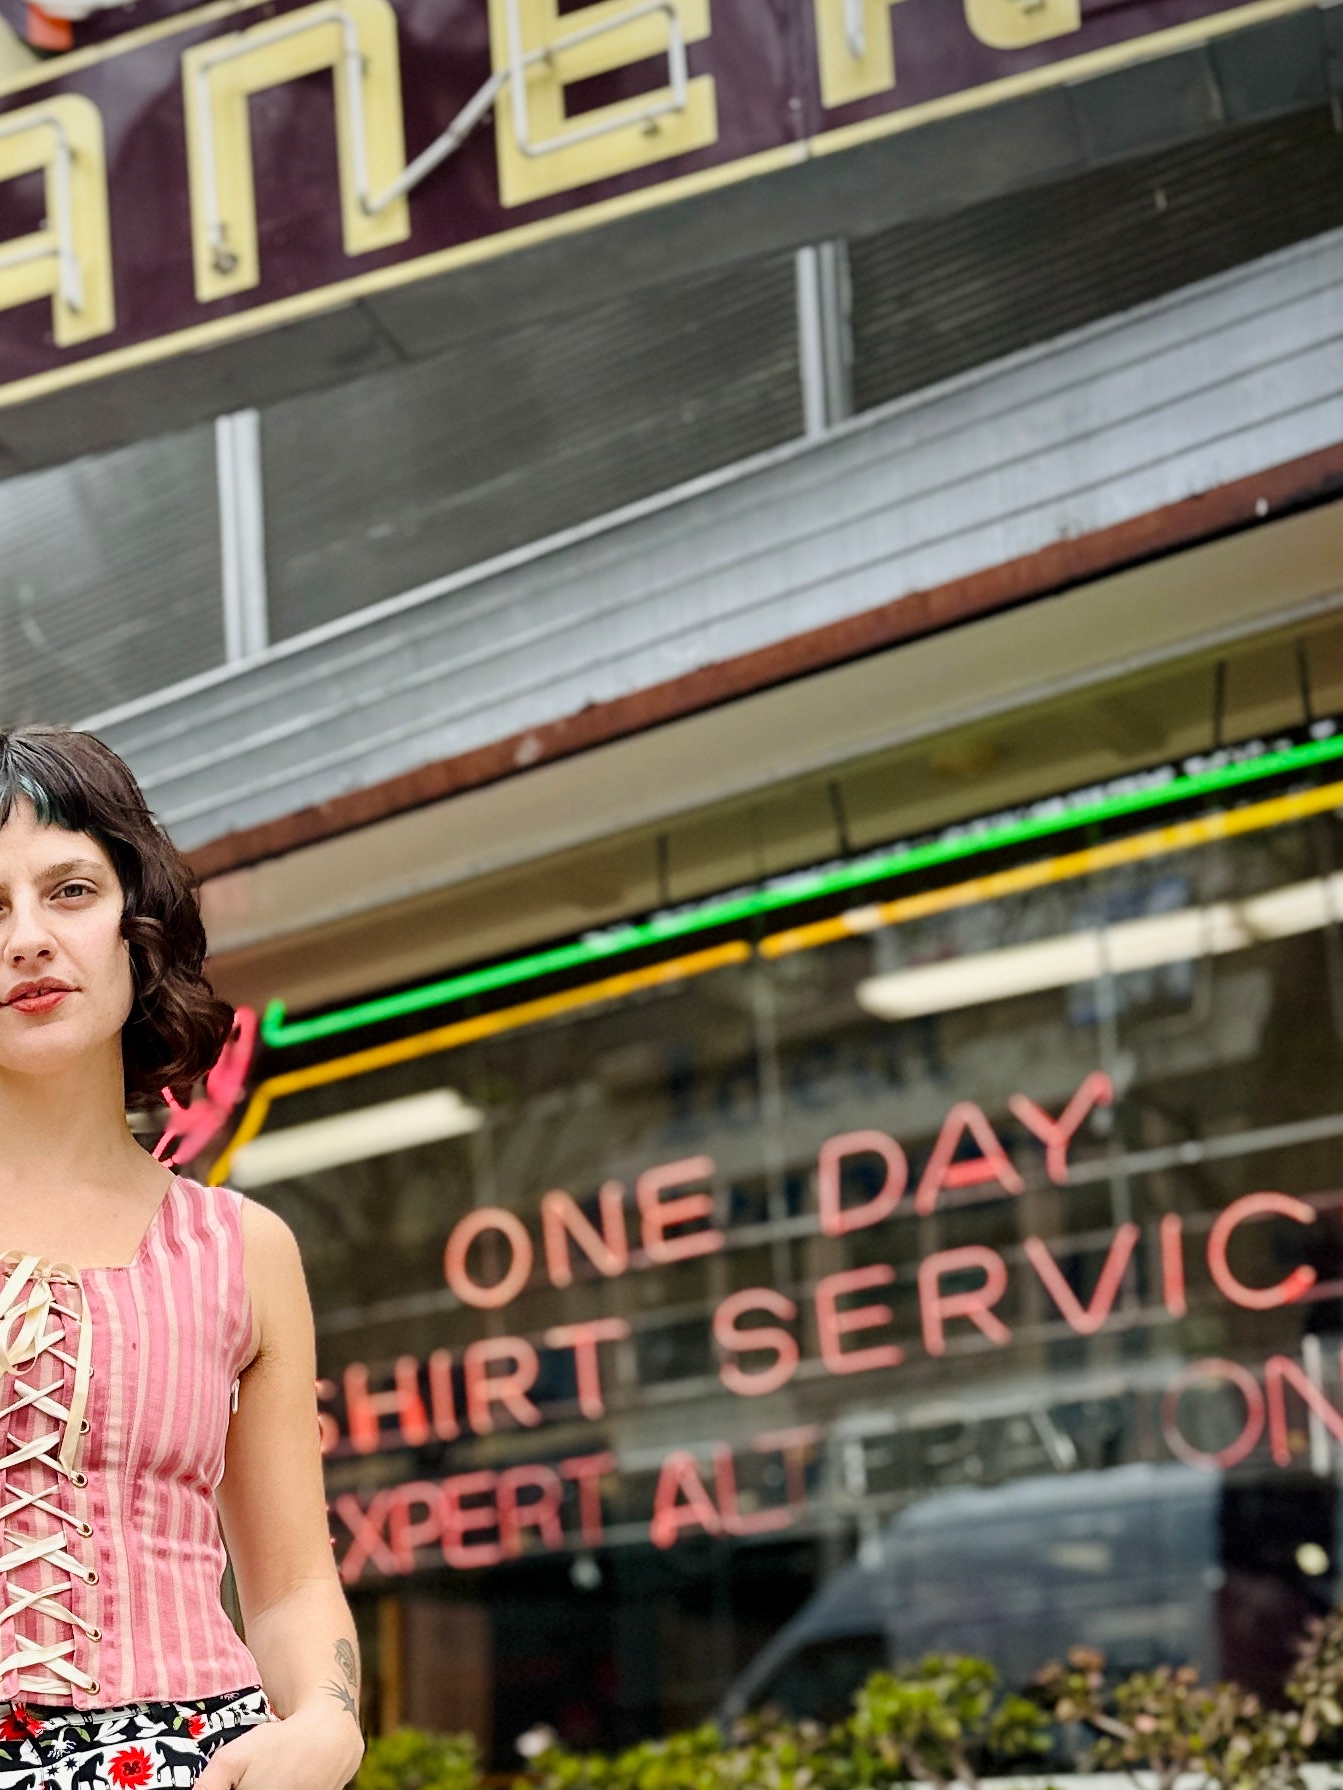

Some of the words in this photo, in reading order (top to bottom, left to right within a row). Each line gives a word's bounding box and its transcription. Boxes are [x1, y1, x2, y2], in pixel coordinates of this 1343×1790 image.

[443, 1154, 726, 1309] ONE
[817, 1071, 1116, 1237] DAY
[712, 1190, 1343, 1398] SERVIC
[326, 1450, 616, 1586] XPERT
